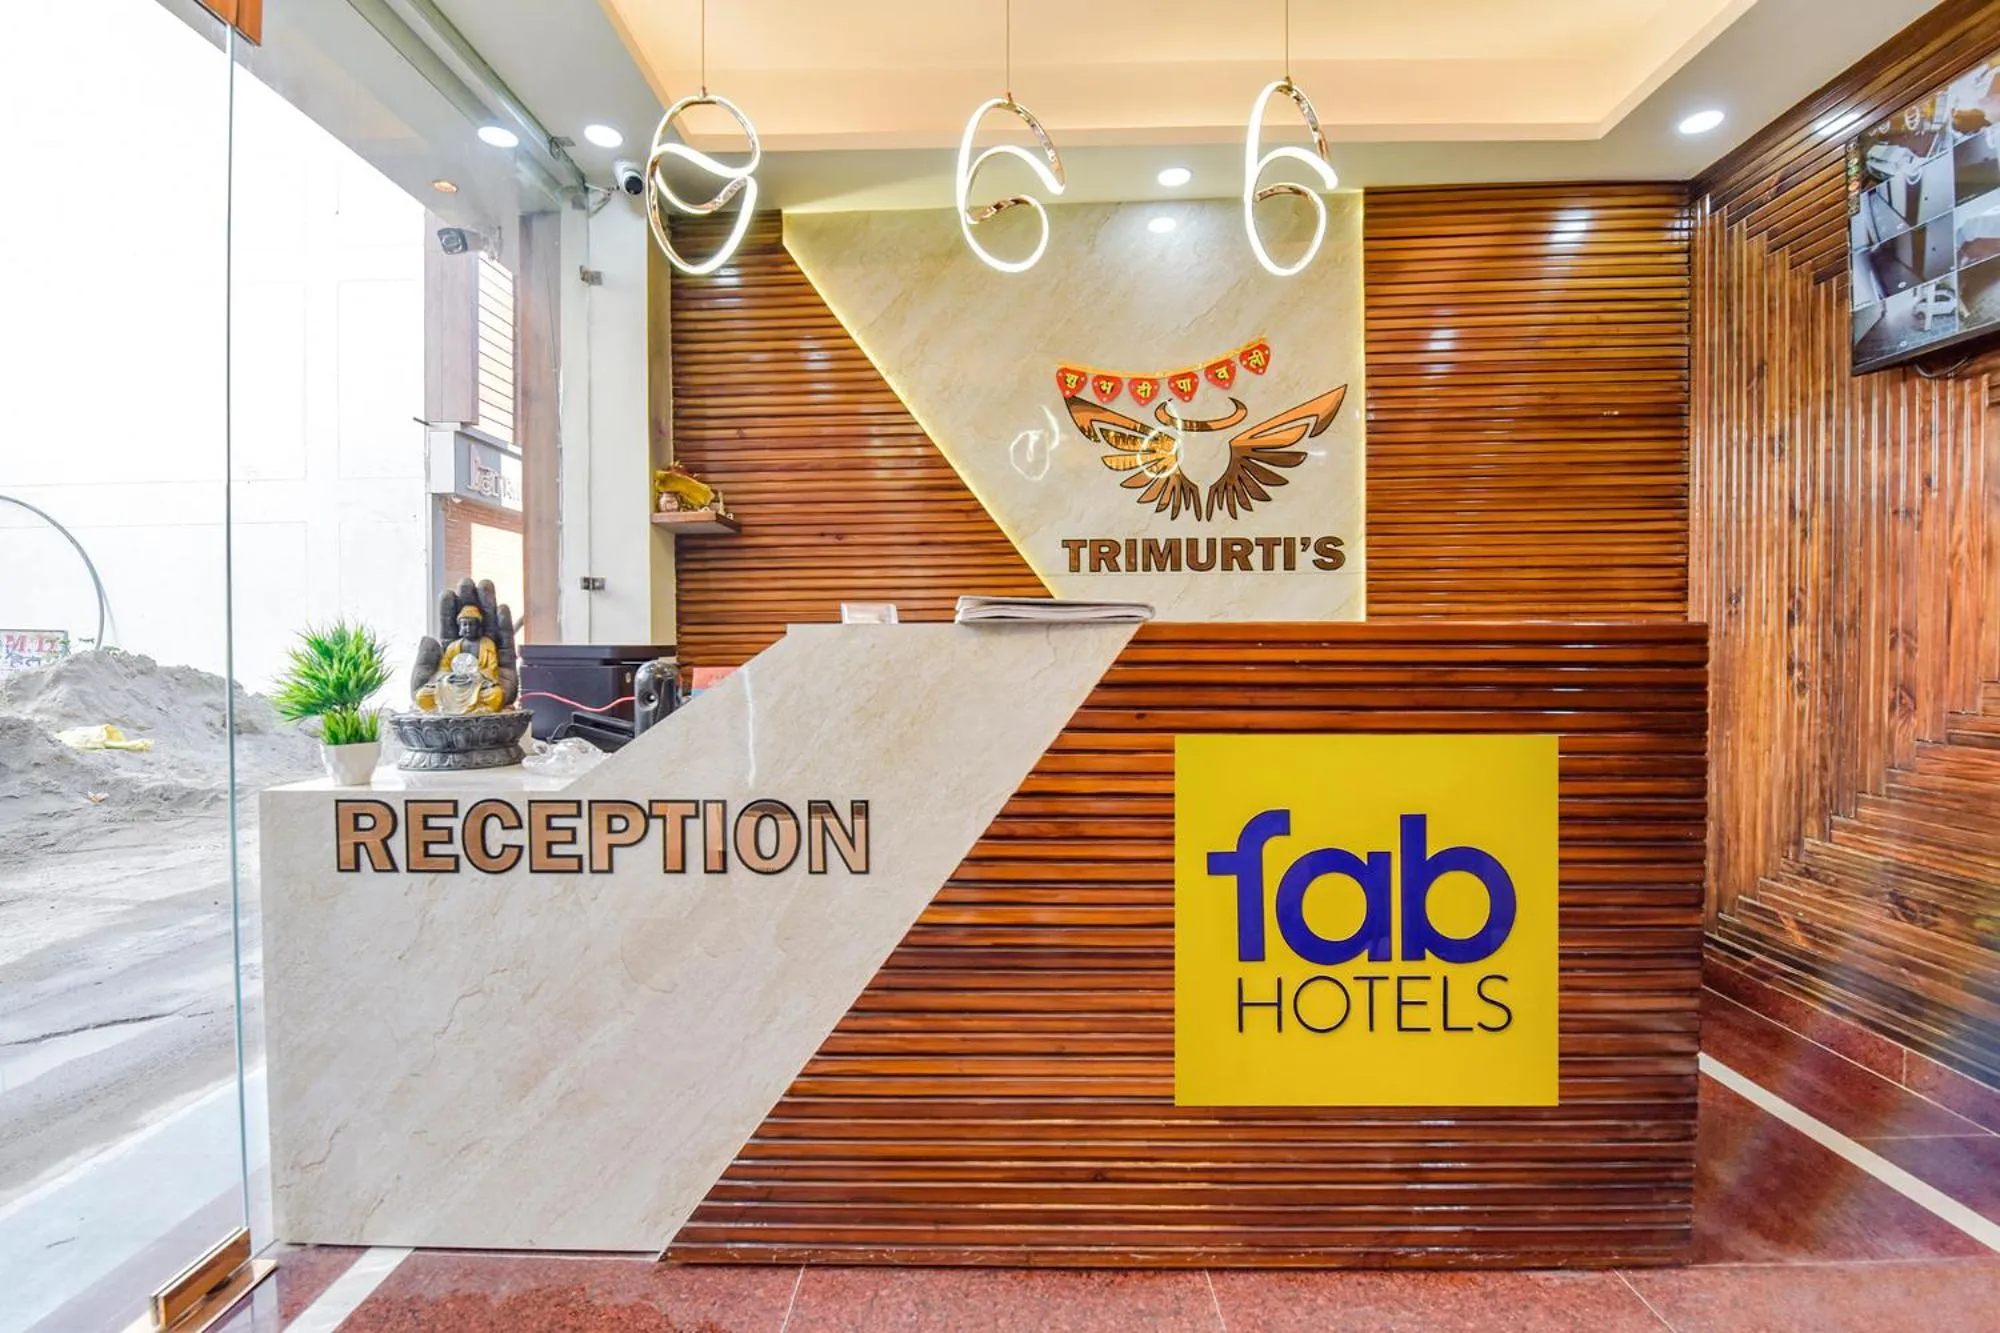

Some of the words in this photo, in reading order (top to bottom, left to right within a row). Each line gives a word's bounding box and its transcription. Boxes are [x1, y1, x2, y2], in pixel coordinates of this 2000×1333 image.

[1061, 536, 1346, 572] TRIMURTI'S
[335, 799, 870, 874] RECEPTION
[1207, 809, 1517, 965] fab
[1238, 975, 1513, 1033] HOTELS
